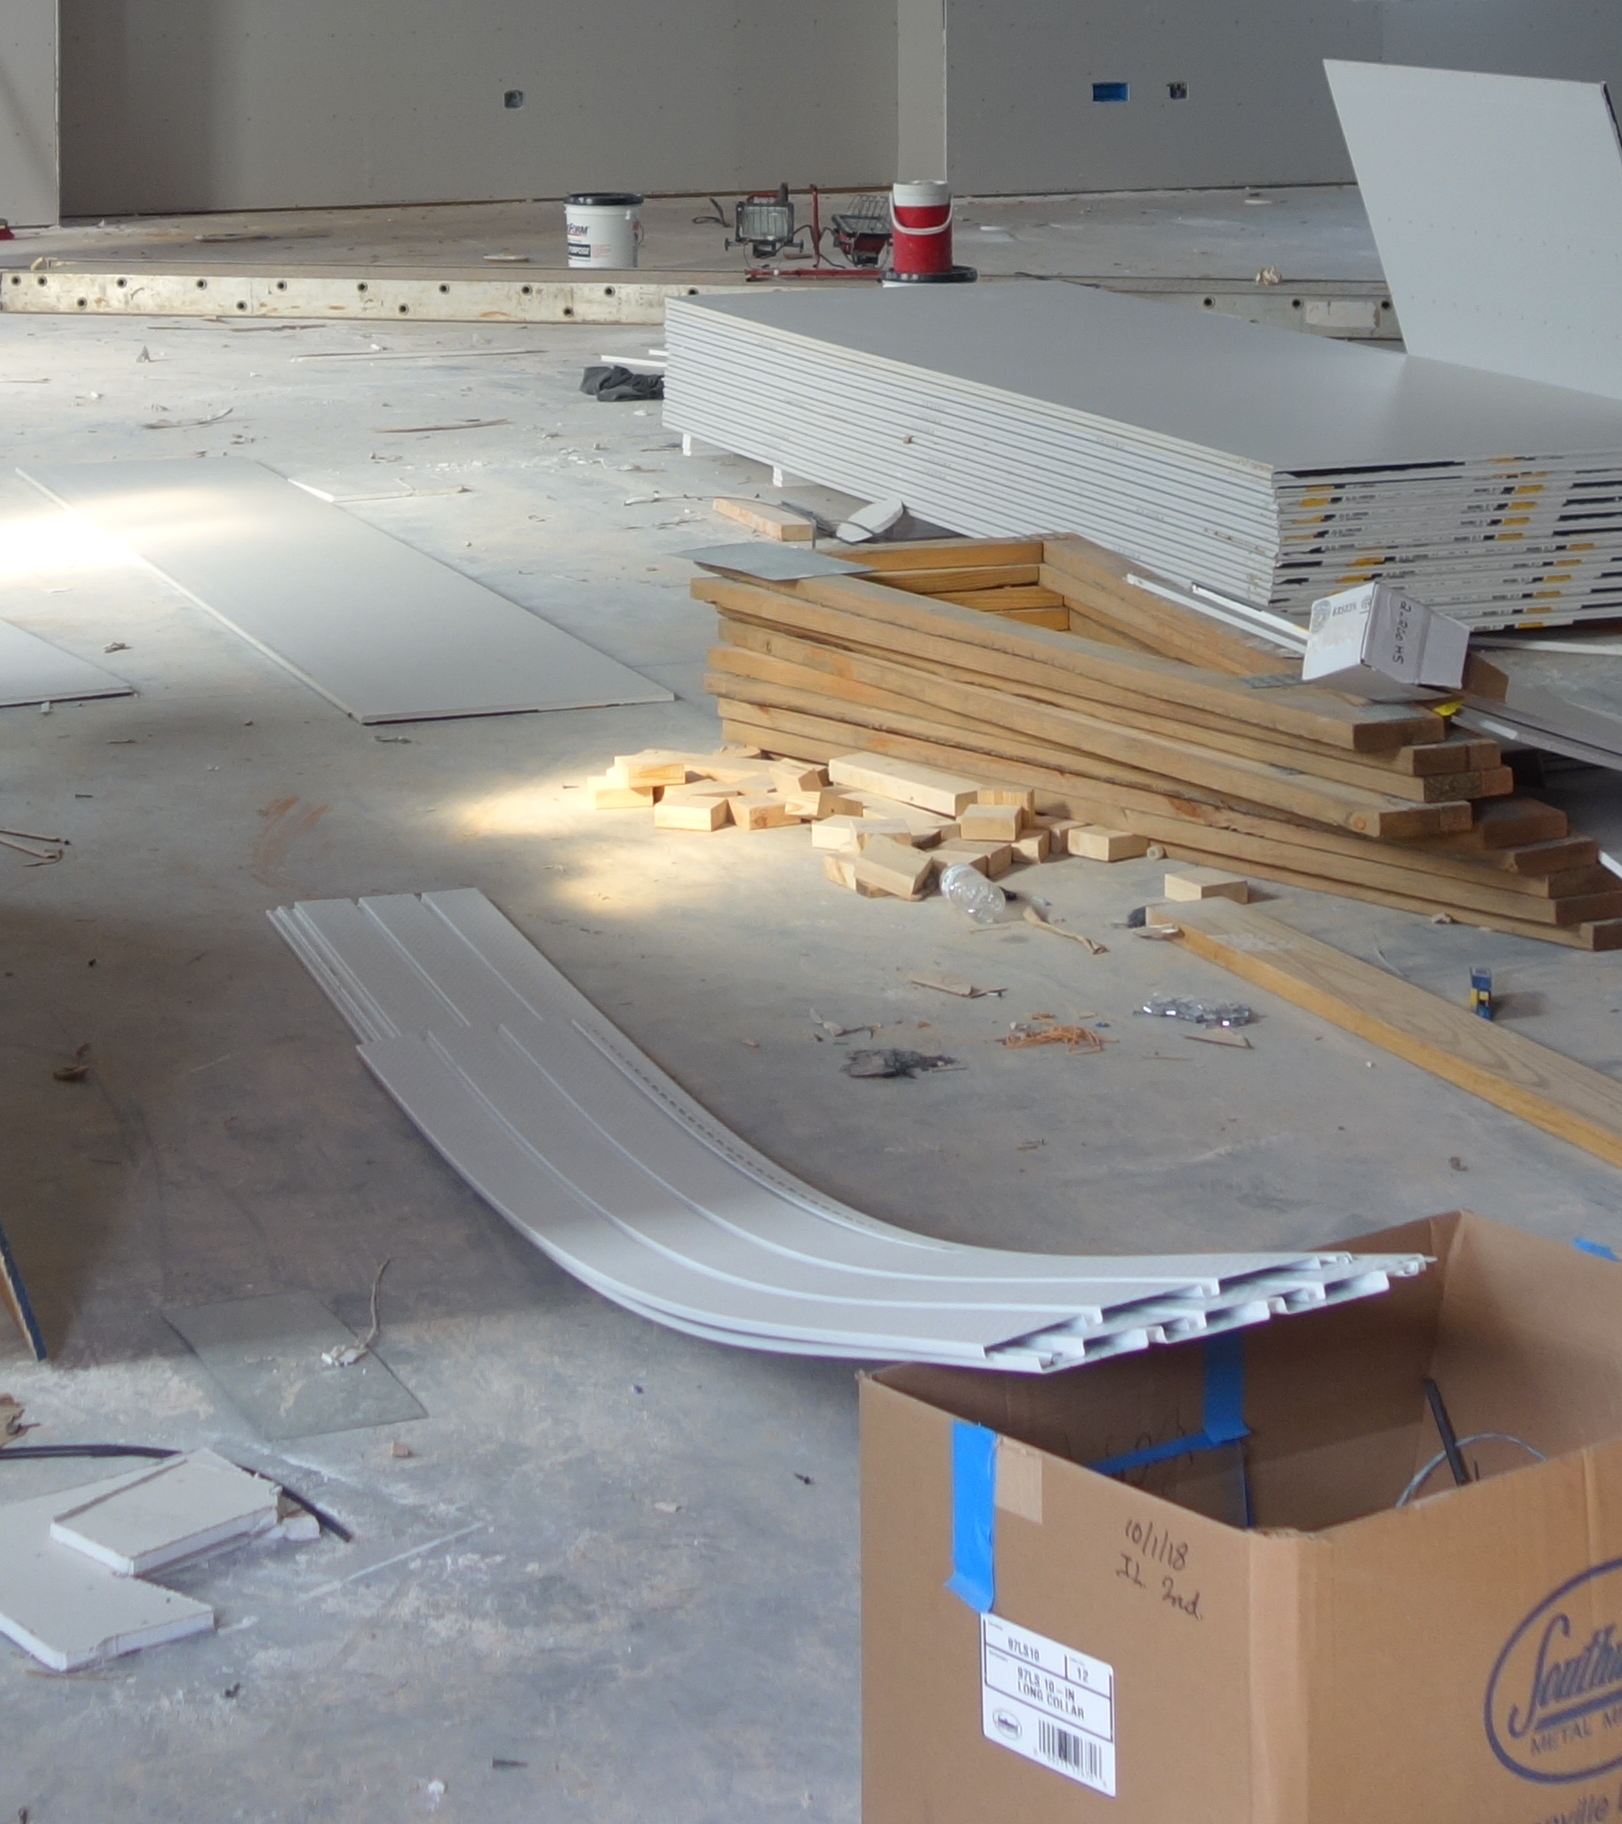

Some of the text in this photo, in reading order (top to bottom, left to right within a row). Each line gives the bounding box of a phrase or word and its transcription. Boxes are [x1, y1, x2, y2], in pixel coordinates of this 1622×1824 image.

[1125, 1519, 1189, 1572] 10/1/18
[1008, 1636, 1090, 1683] 97LS10 12
[1017, 1666, 1041, 1688] 97LS
[1017, 1680, 1085, 1720] LONG COLLAR
[1530, 1719, 1593, 1757] METAL
